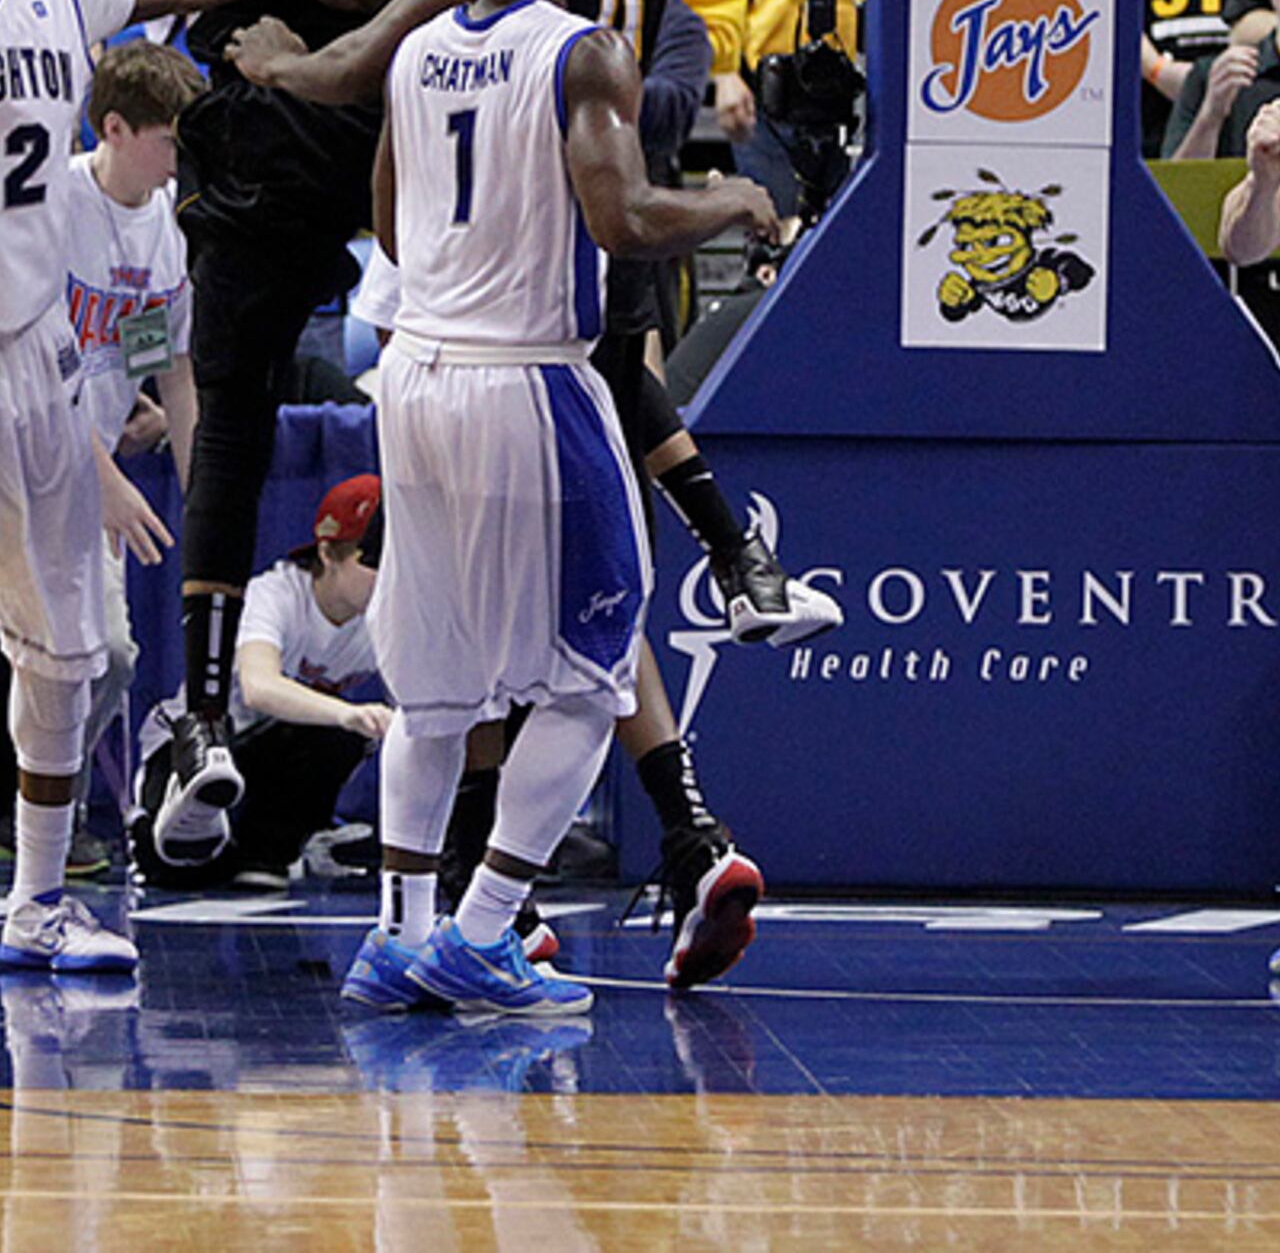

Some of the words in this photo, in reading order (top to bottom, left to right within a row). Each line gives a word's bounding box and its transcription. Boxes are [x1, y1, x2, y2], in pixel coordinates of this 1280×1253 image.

[420, 49, 514, 92] CHATMAN
[446, 107, 478, 224] 1
[790, 647, 950, 682] Health
[980, 647, 1090, 682] Care
